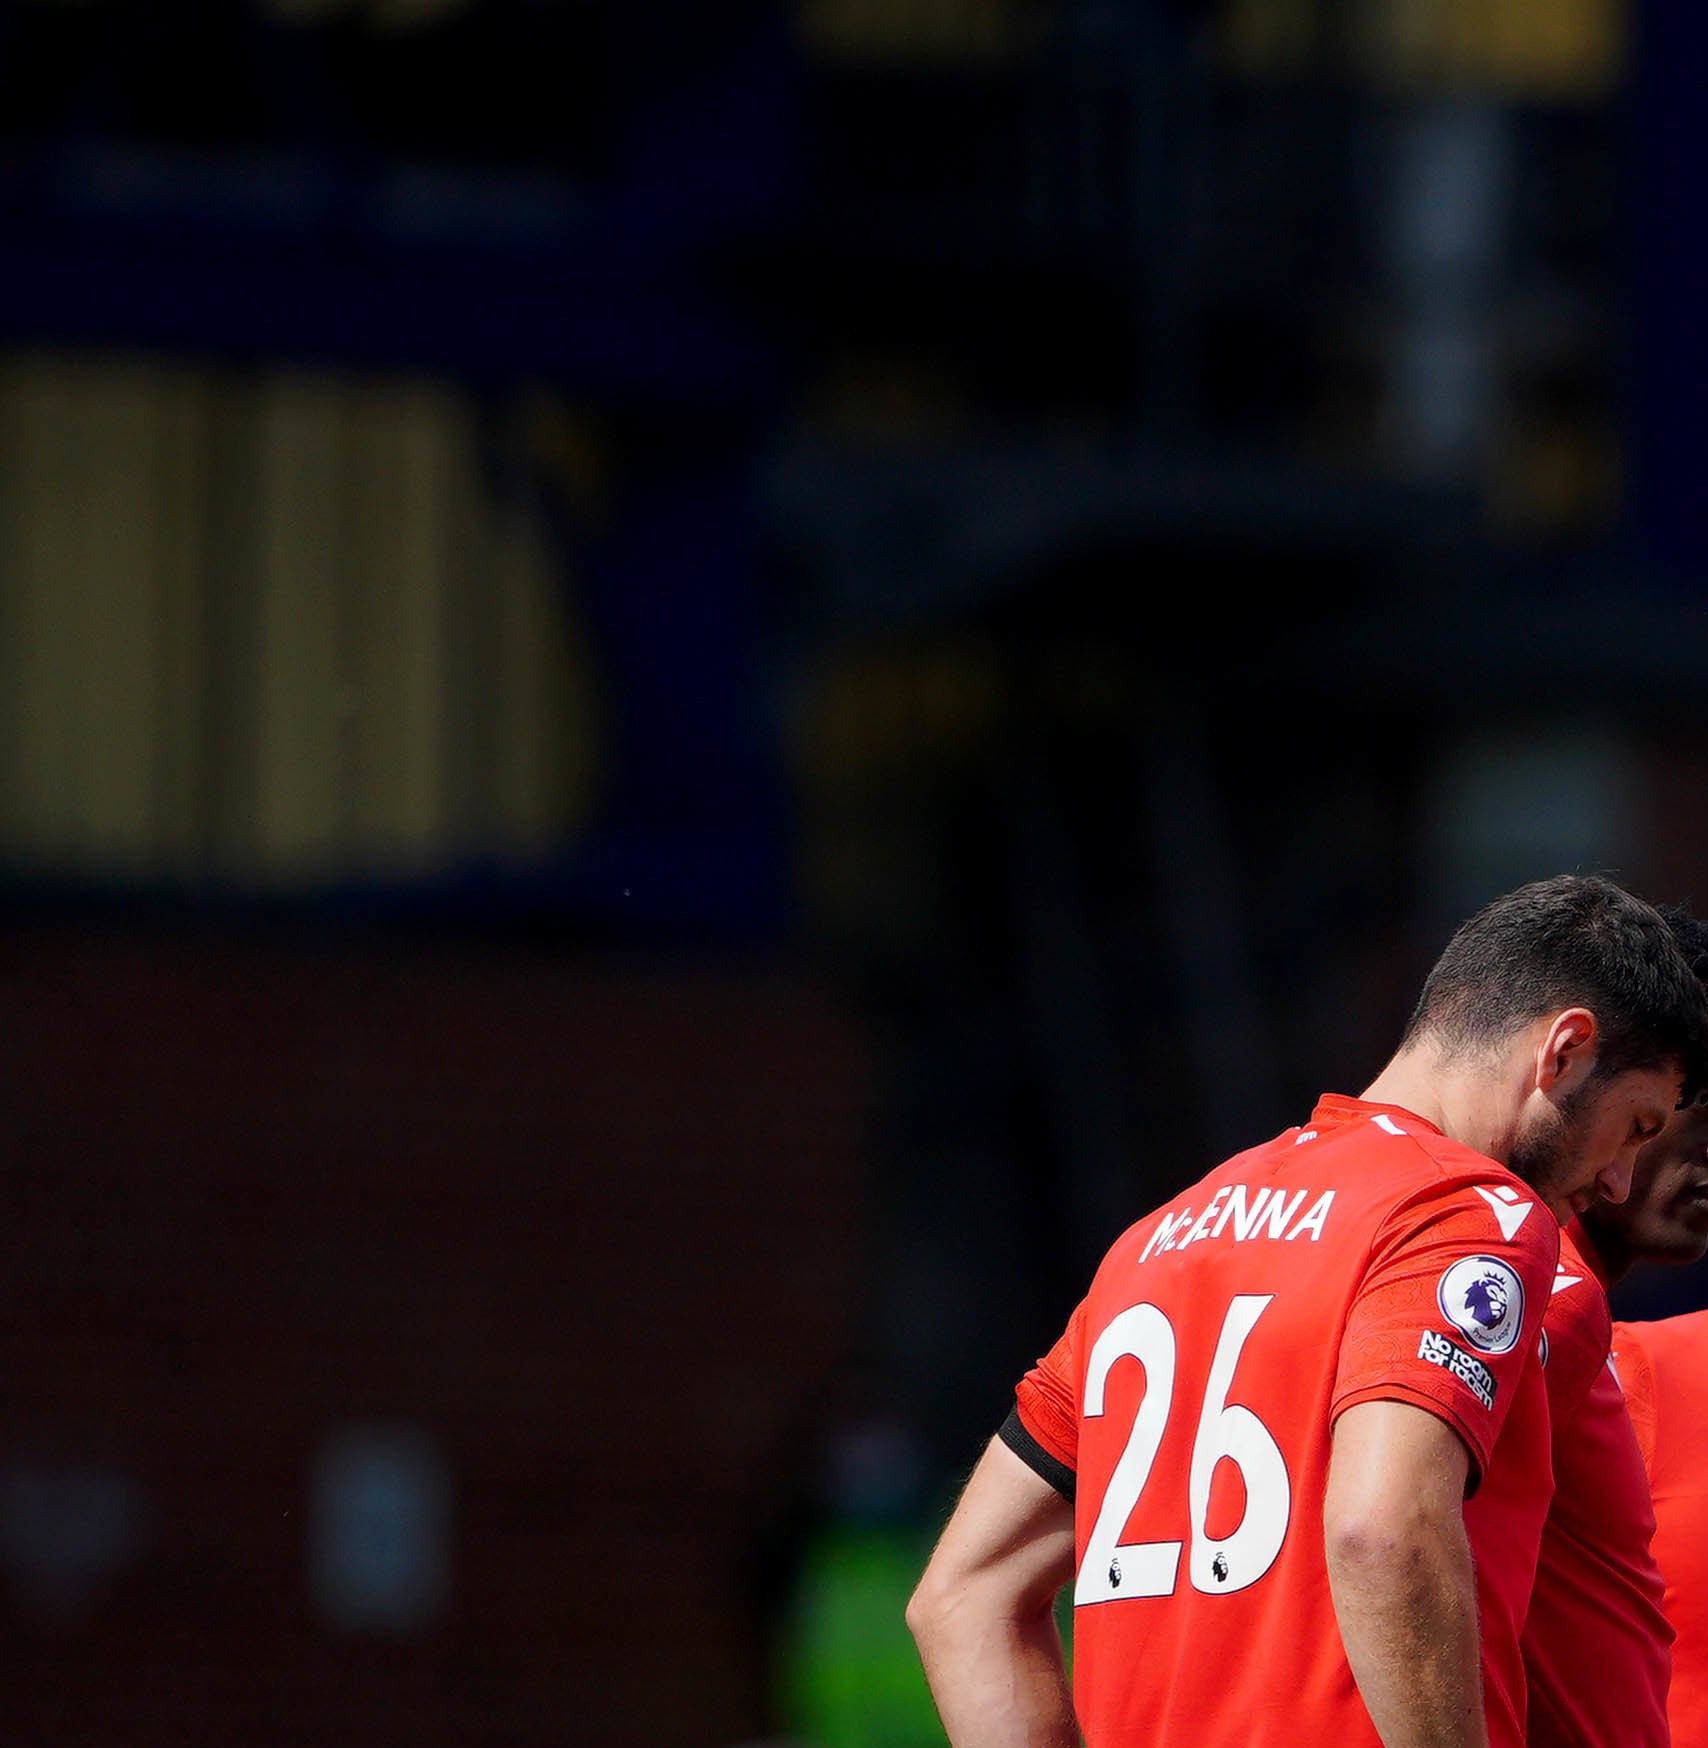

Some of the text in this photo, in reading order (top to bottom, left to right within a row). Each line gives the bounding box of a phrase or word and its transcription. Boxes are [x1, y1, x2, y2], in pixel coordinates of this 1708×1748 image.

[1137, 1184, 1337, 1264] McENNA
[1420, 1329, 1492, 1391] No room
[1448, 1358, 1494, 1412] racism
[1074, 1293, 1292, 1606] 26
